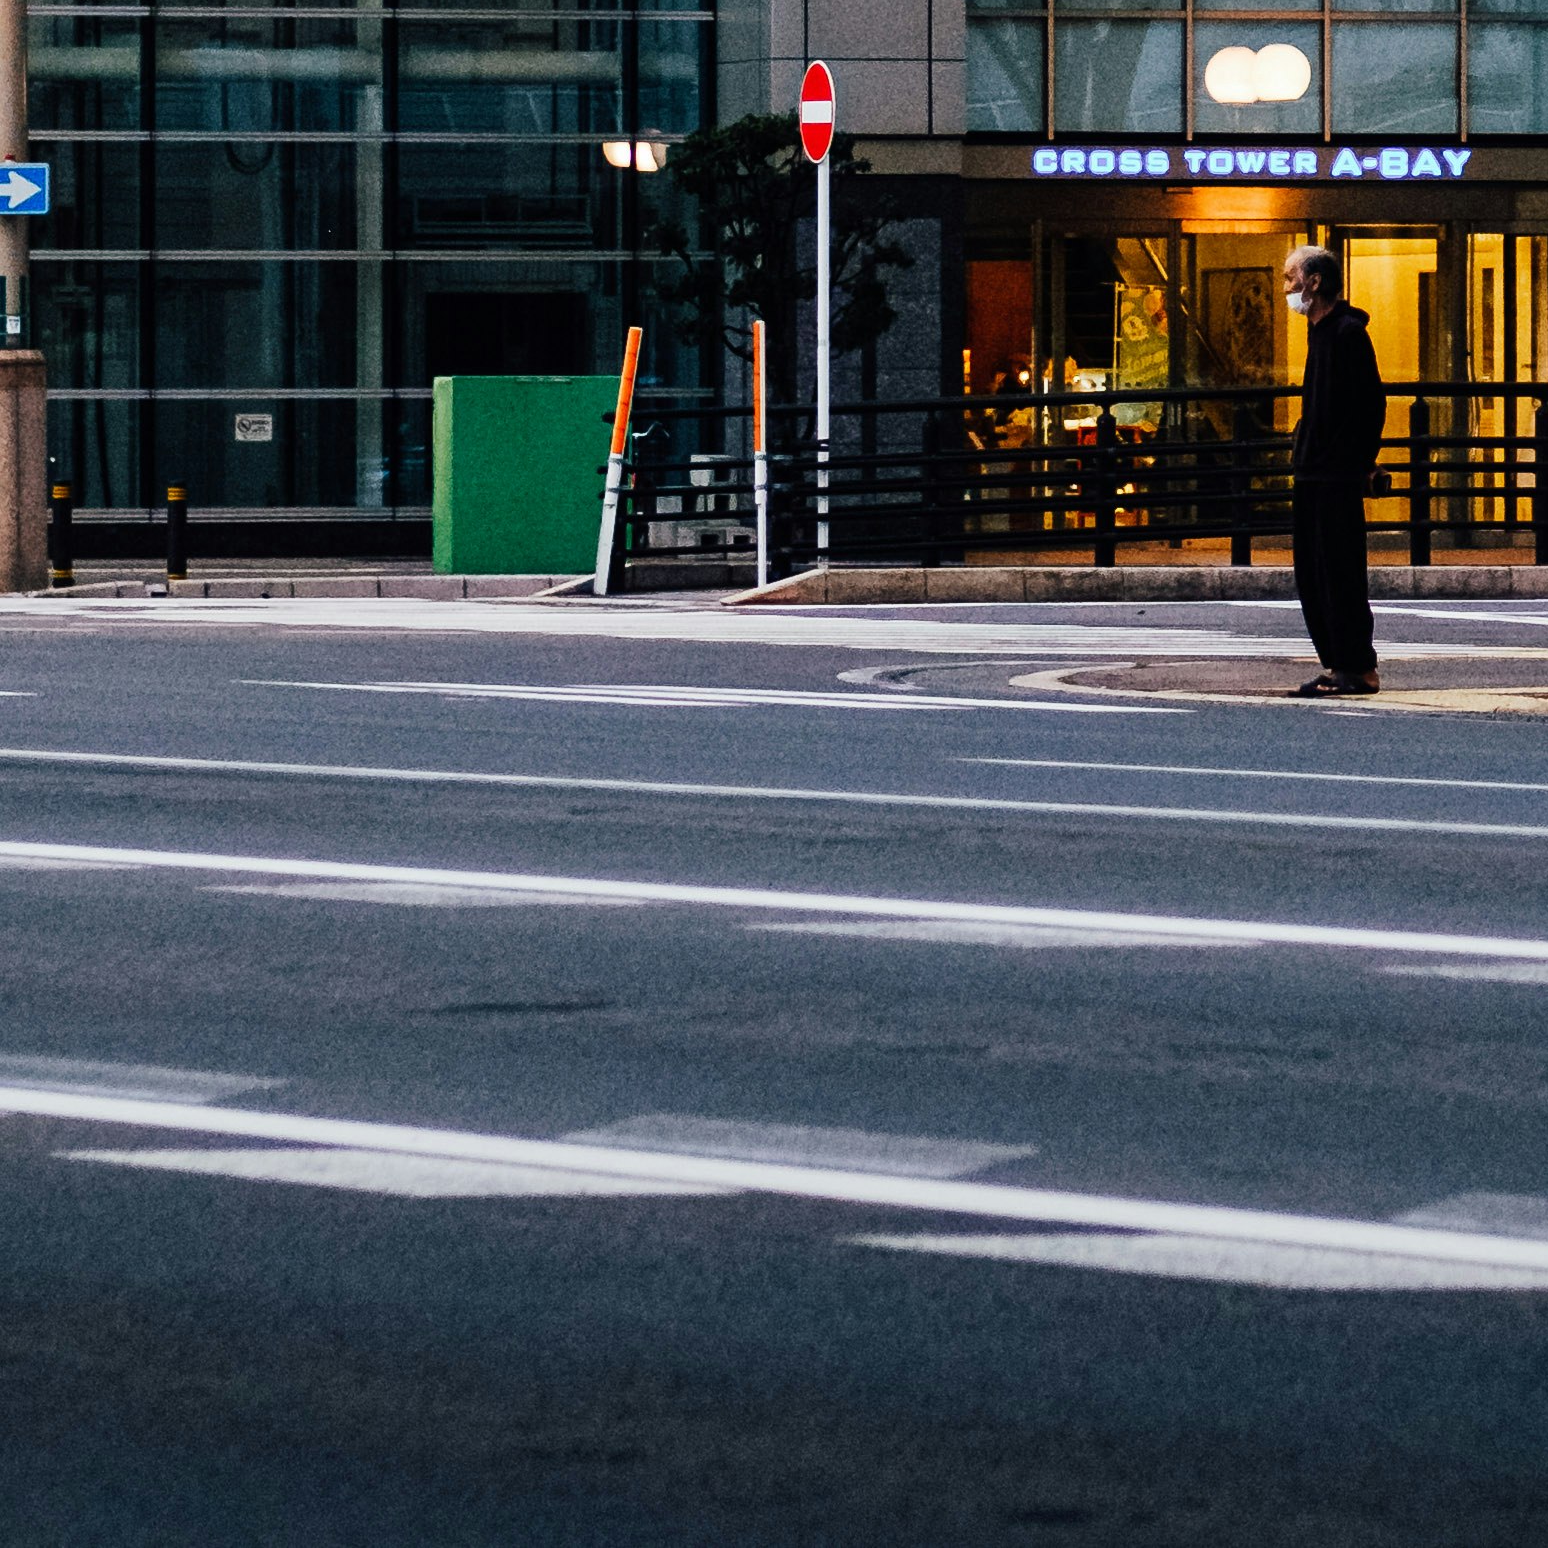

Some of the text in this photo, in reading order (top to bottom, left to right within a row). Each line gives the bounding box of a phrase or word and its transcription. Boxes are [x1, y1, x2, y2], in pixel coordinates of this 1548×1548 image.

[1033, 147, 1472, 179] CROSS TOWER A-BAY
